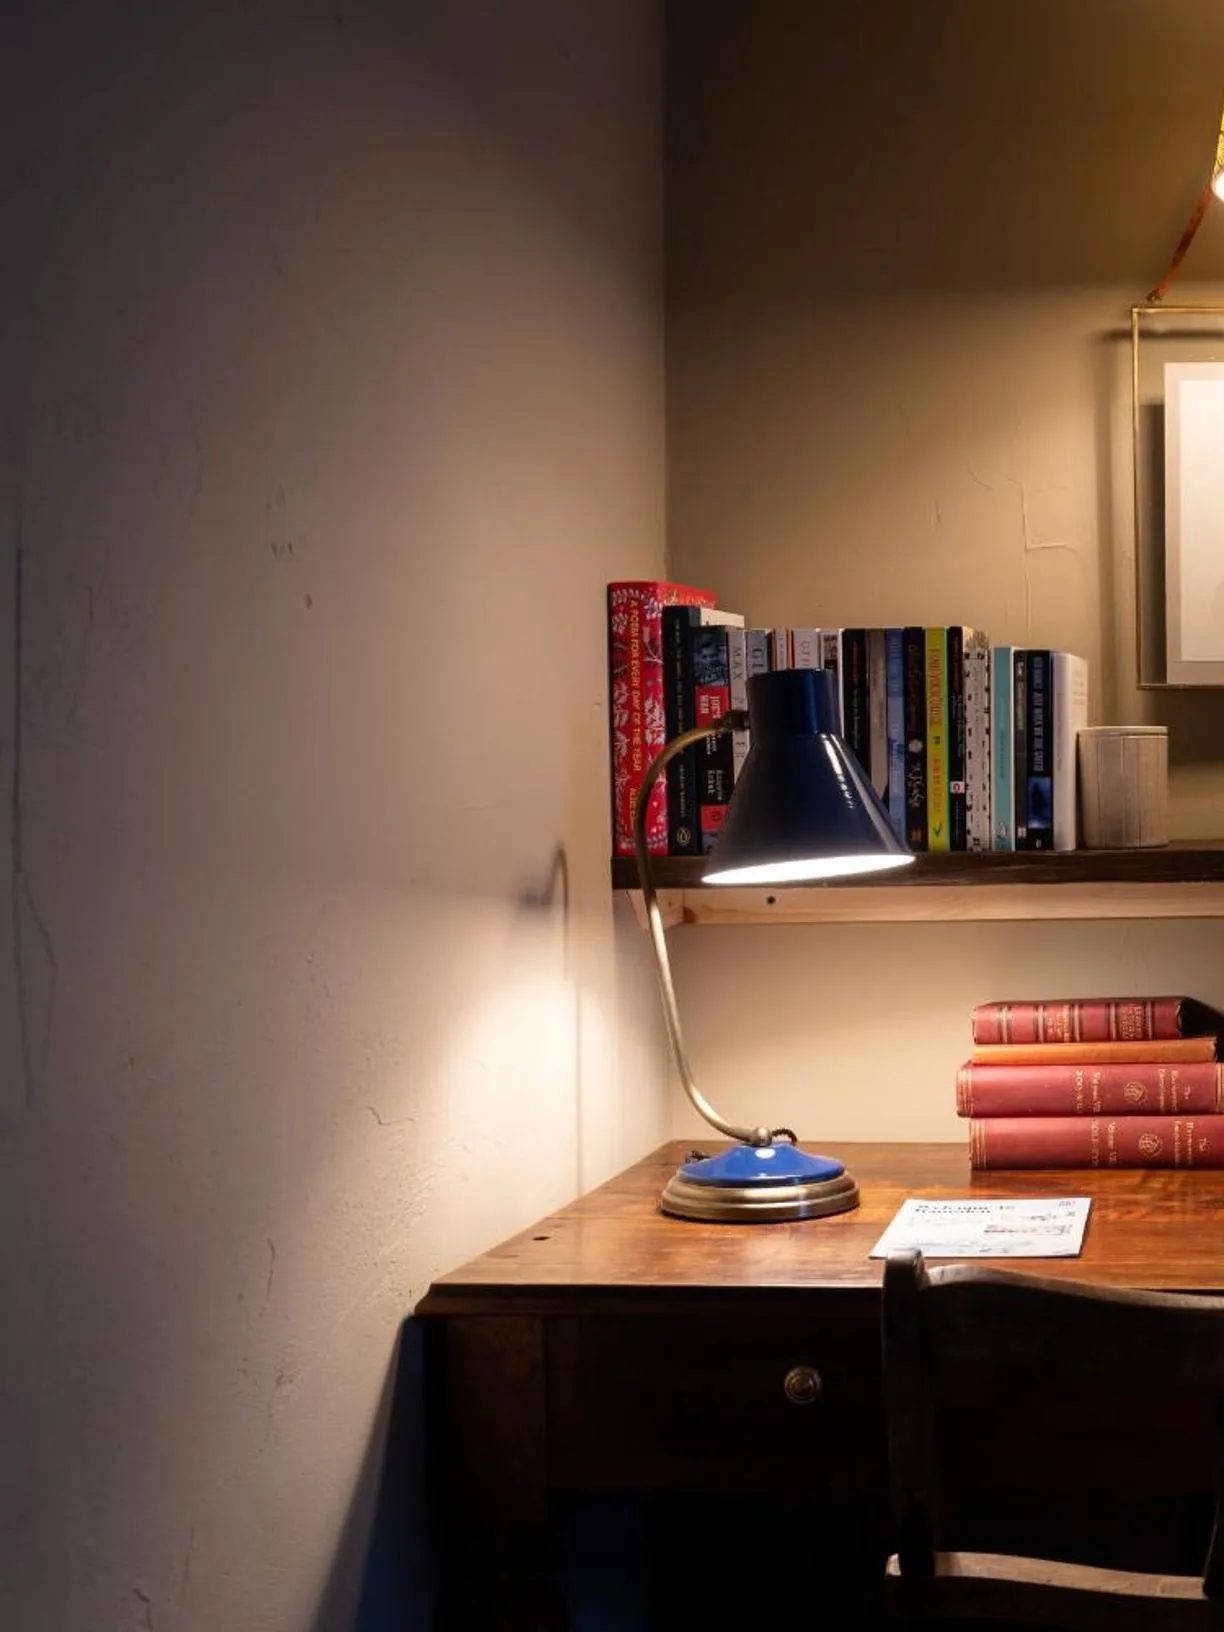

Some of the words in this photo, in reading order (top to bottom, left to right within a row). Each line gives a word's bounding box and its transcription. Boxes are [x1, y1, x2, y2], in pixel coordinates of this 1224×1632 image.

[630, 599, 640, 608] A
[630, 610, 640, 637] POEM
[630, 639, 640, 658] FOR
[631, 660, 640, 688] EVERY
[632, 691, 641, 709] DAY
[632, 727, 641, 745] THE
[632, 748, 642, 772] YEAR
